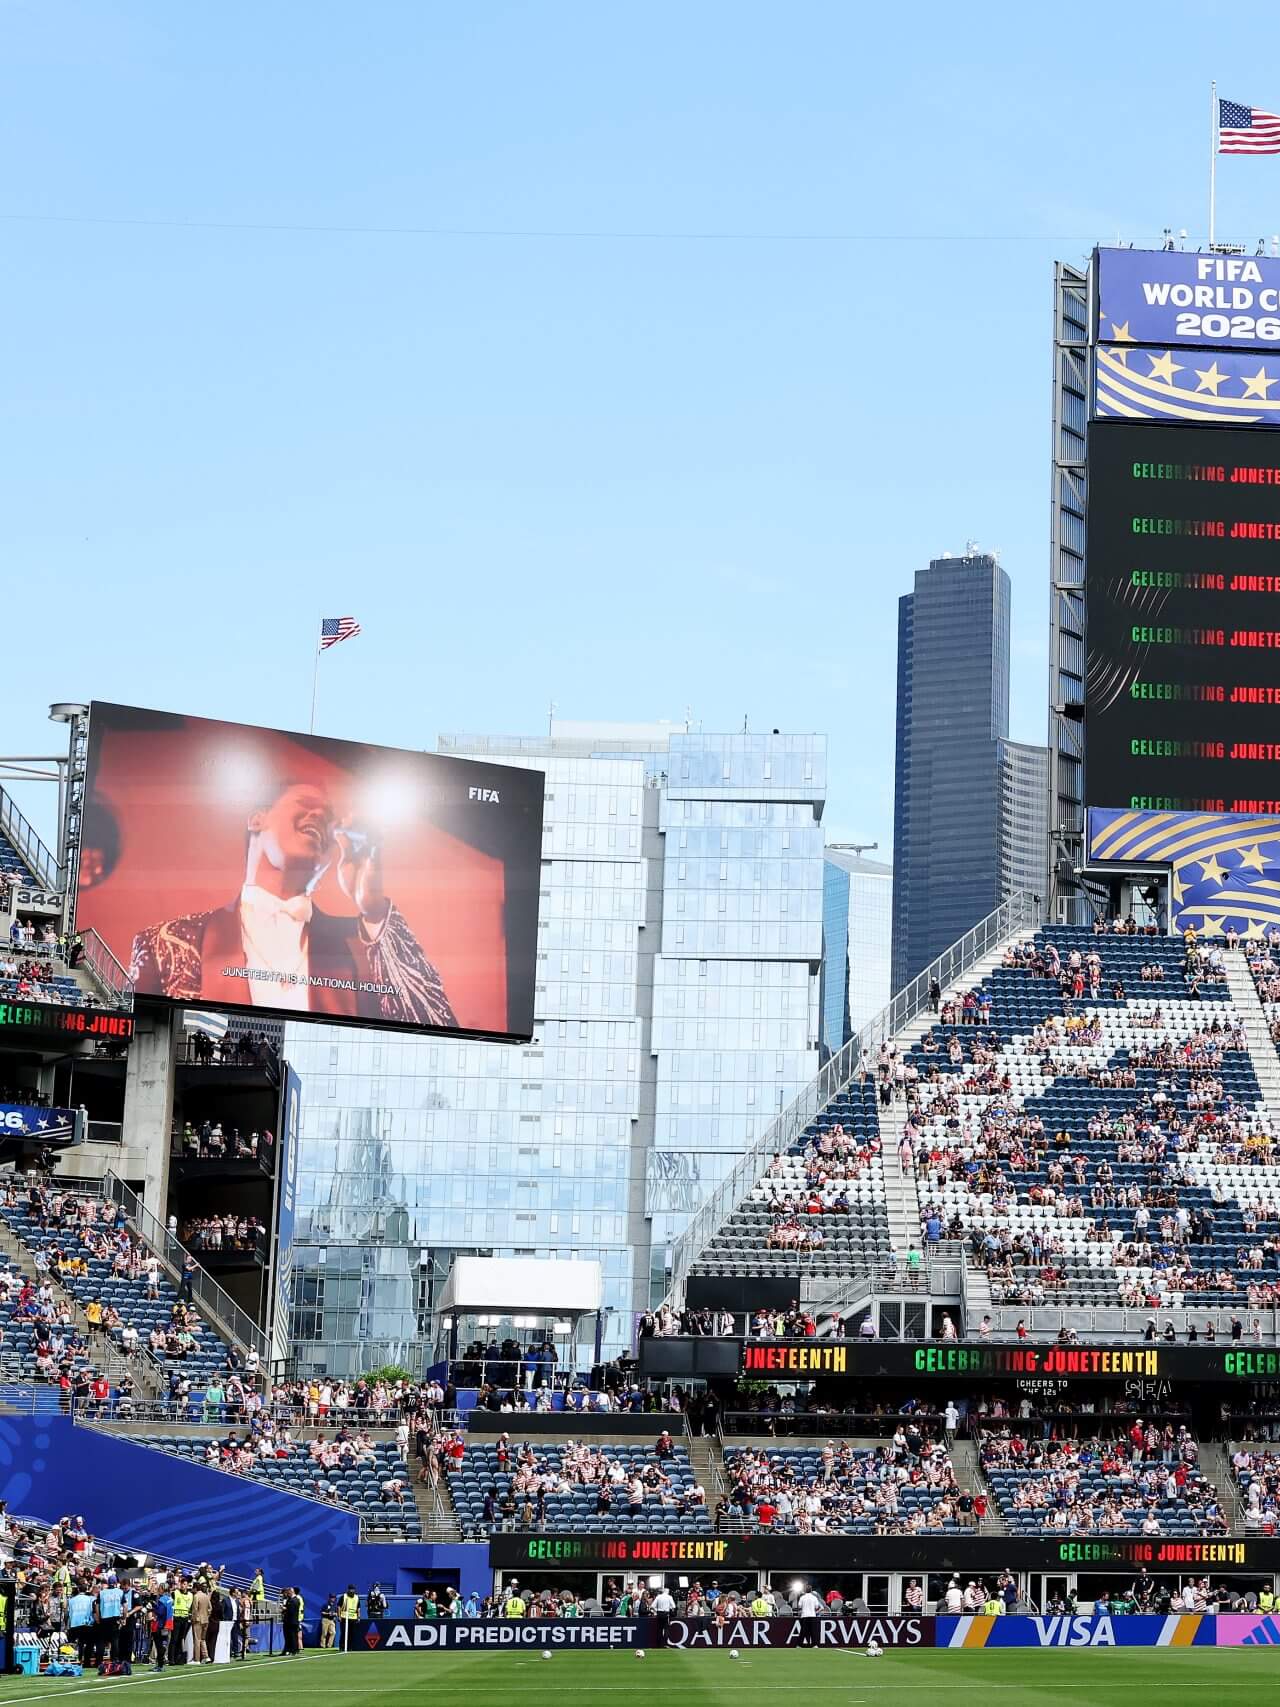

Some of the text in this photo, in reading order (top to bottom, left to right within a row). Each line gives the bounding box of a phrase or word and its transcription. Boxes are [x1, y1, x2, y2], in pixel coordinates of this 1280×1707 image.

[1198, 258, 1263, 282] FIFA
[1142, 283, 1257, 310] WORLD
[469, 786, 500, 803] FIFA
[17, 890, 62, 908] 344
[222, 967, 286, 984] JUNETEENTH
[288, 975, 298, 984] IS
[309, 977, 357, 991] NATIONAL
[915, 1347, 1158, 1376] CELEBRATING JUNETEENTH
[1019, 1380, 1068, 1388] CHEERS TO
[632, 1540, 724, 1561] JUNETEENTH
[1157, 1543, 1245, 1564] JUNETEENTH
[385, 1624, 637, 1647] ADI PREDICTSTREET
[667, 1619, 922, 1649] QATAR ARWAYS
[1026, 1616, 1116, 1646] VISA
